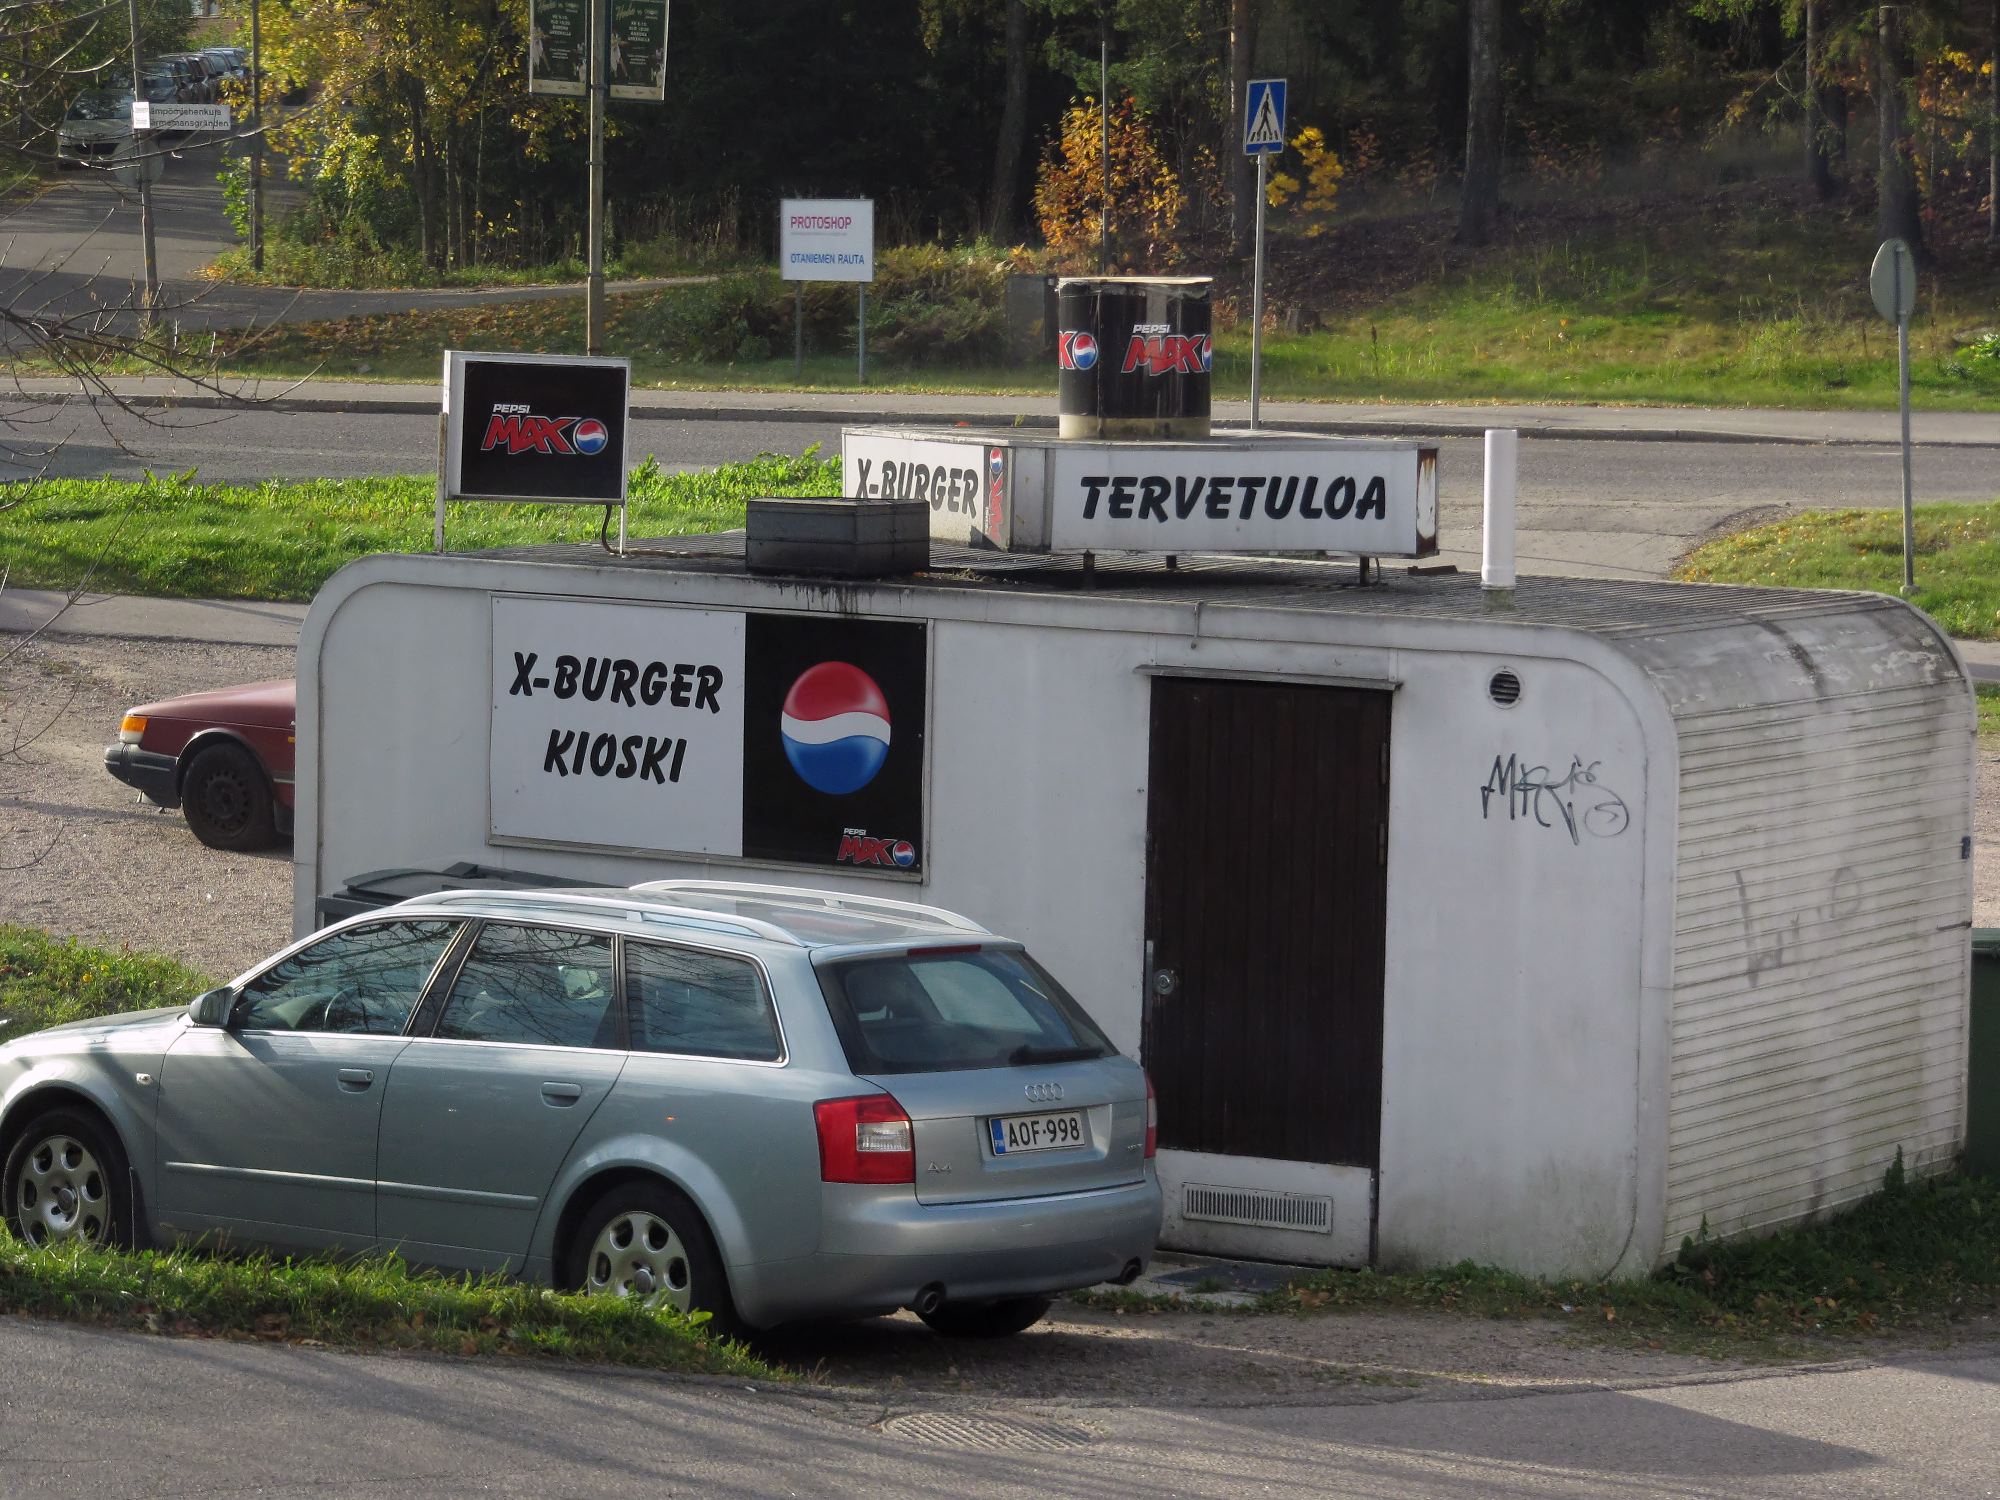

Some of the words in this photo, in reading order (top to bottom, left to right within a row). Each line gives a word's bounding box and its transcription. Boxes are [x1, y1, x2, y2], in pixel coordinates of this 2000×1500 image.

[790, 216, 852, 229] PROTOSHOP
[790, 253, 835, 264] OTANIEMEN
[837, 254, 865, 265] RAUTA
[1132, 324, 1171, 334] PEPSI
[1121, 334, 1206, 376] MAX
[492, 403, 531, 414] PEPSI
[480, 413, 582, 455] MAX
[855, 458, 979, 519] X-BURGER
[1080, 476, 1386, 523] TERVETULOA
[509, 651, 724, 714] X-BURGER
[543, 729, 687, 785] KIOSKI
[843, 828, 867, 836] PEPSI
[837, 835, 898, 866] MAX
[1008, 1117, 1080, 1148] AOF-998
